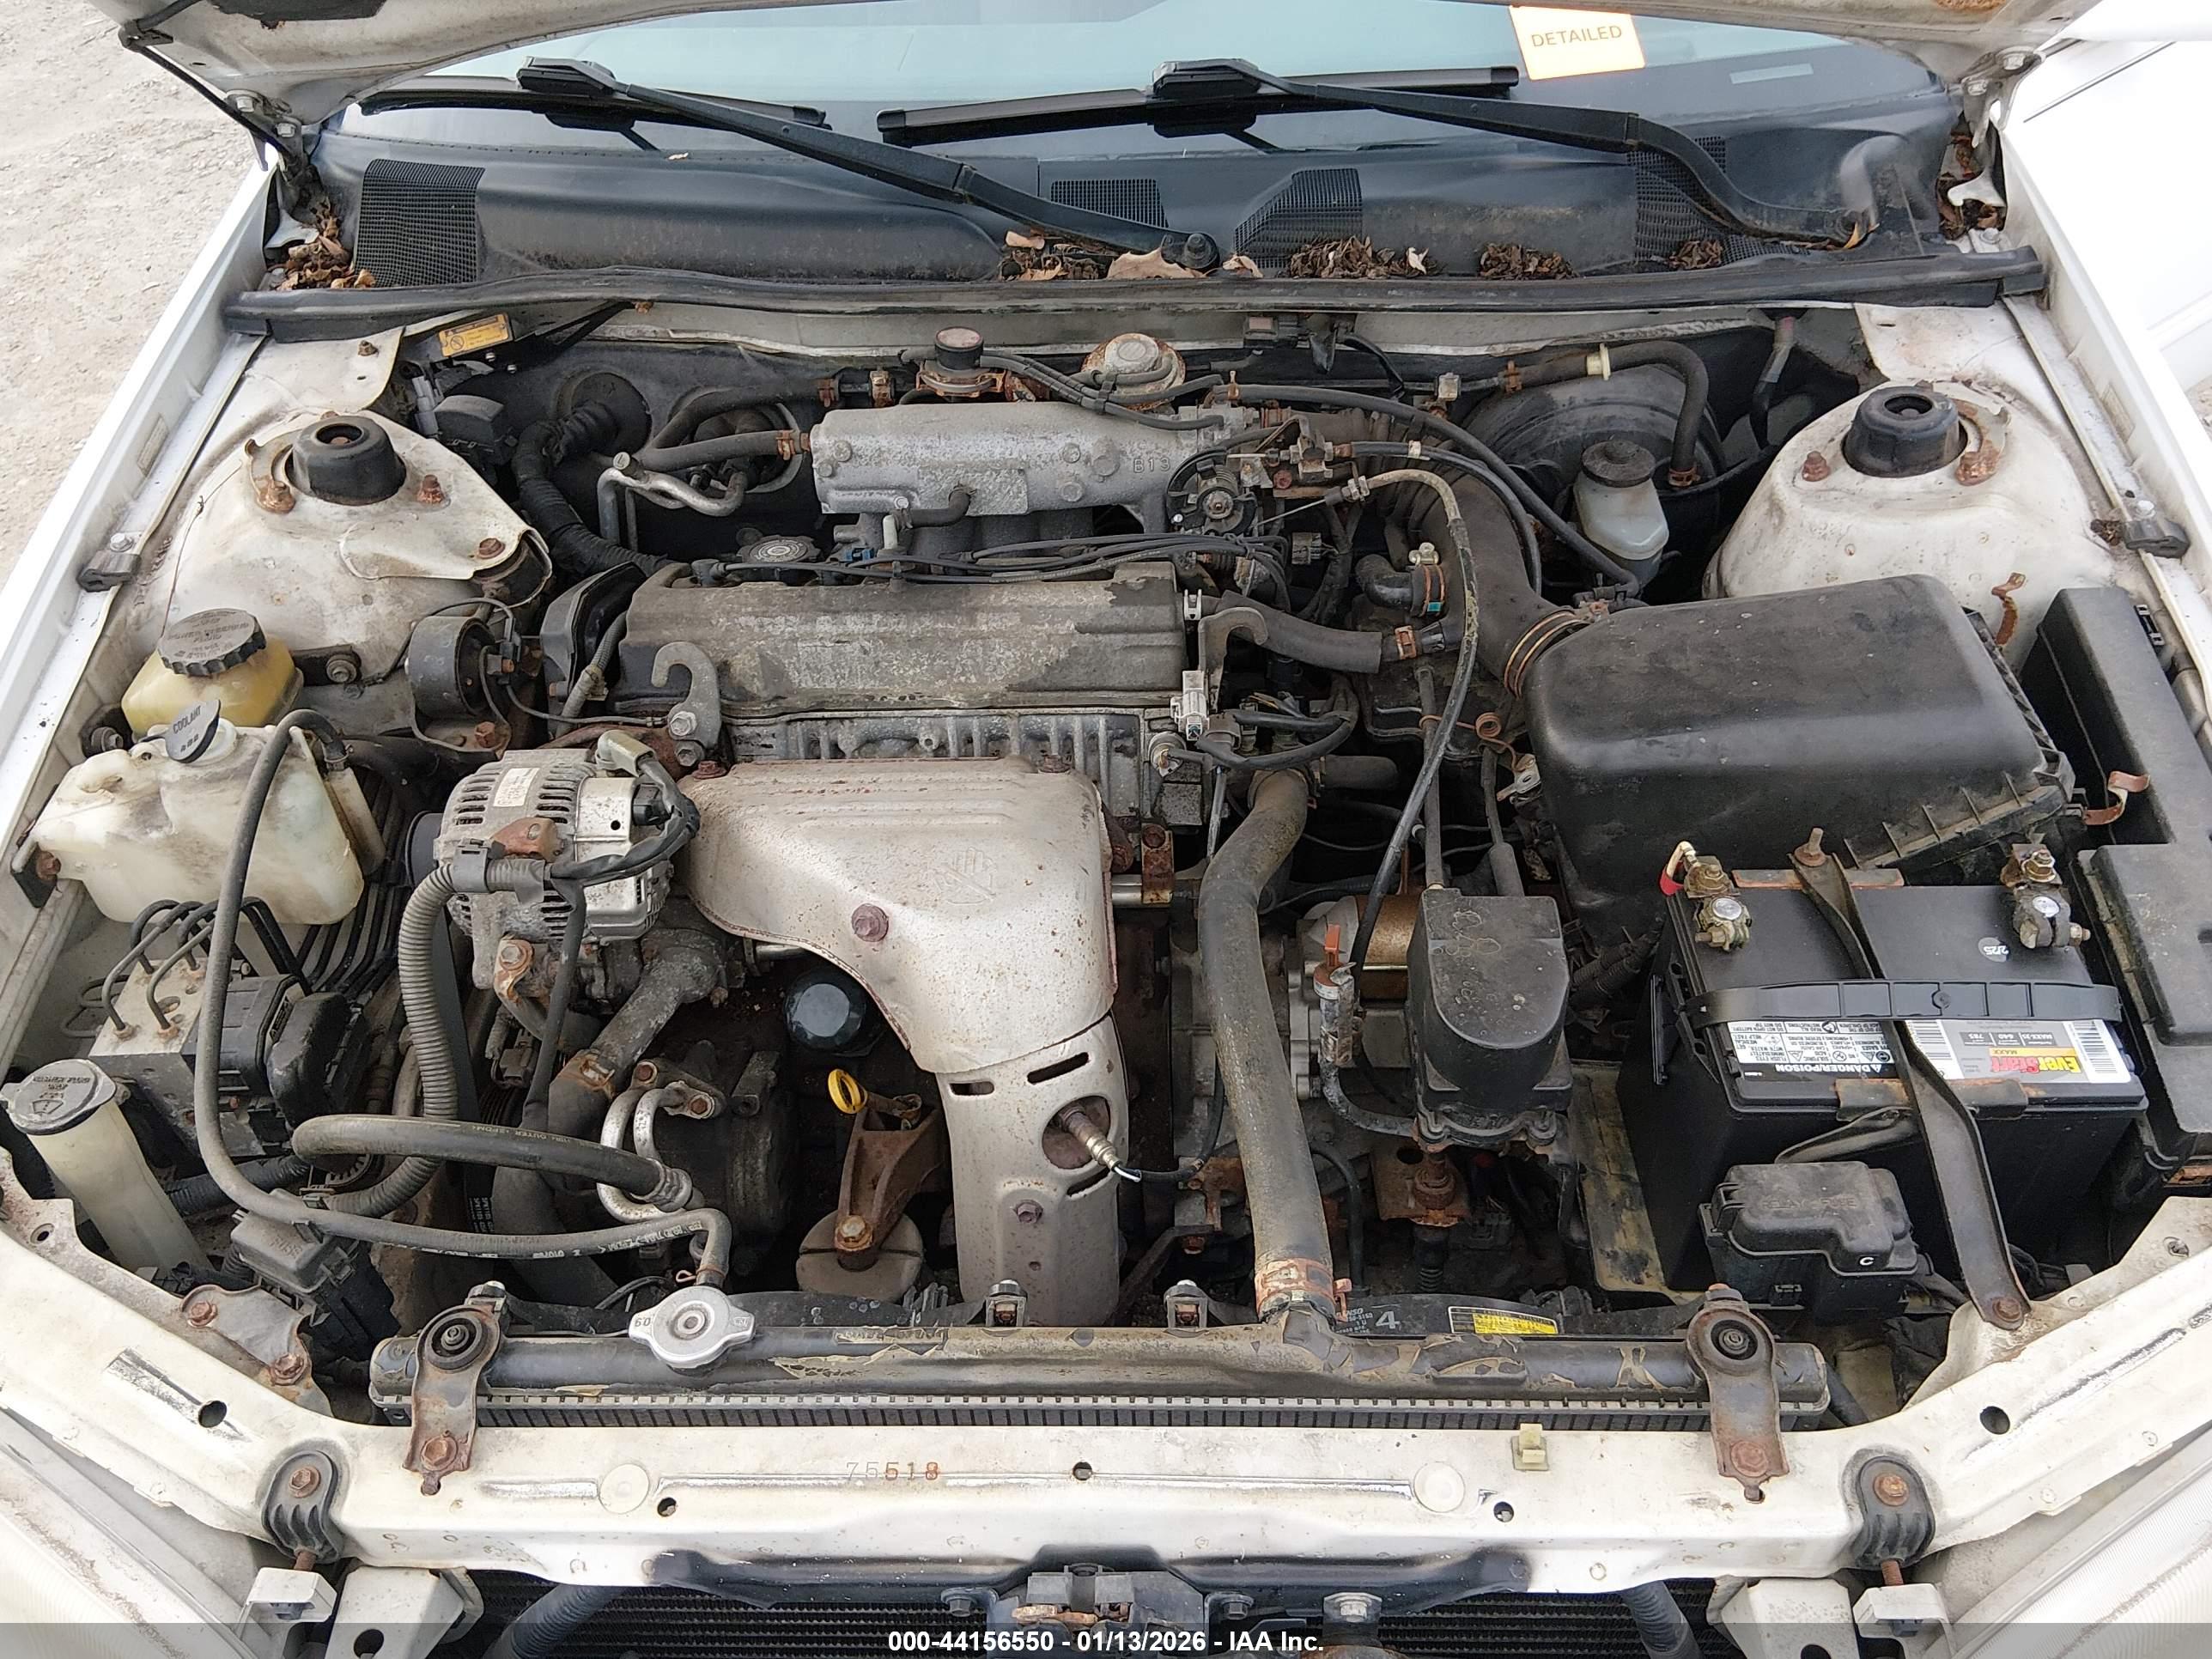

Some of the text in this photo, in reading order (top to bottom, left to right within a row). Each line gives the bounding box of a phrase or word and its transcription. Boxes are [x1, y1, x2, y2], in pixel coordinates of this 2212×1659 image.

[1531, 25, 1622, 47] DETAILED
[1133, 456, 1170, 473] B13
[173, 705, 201, 734] COOLANT
[1775, 1064, 1871, 1073] DANGER/POISON
[1991, 1056, 2081, 1073] EverStart
[515, 1130, 547, 1139] OUTER
[1859, 1256, 1875, 1266] C
[1376, 1310, 1401, 1329] 4
[846, 1462, 939, 1481] 75518
